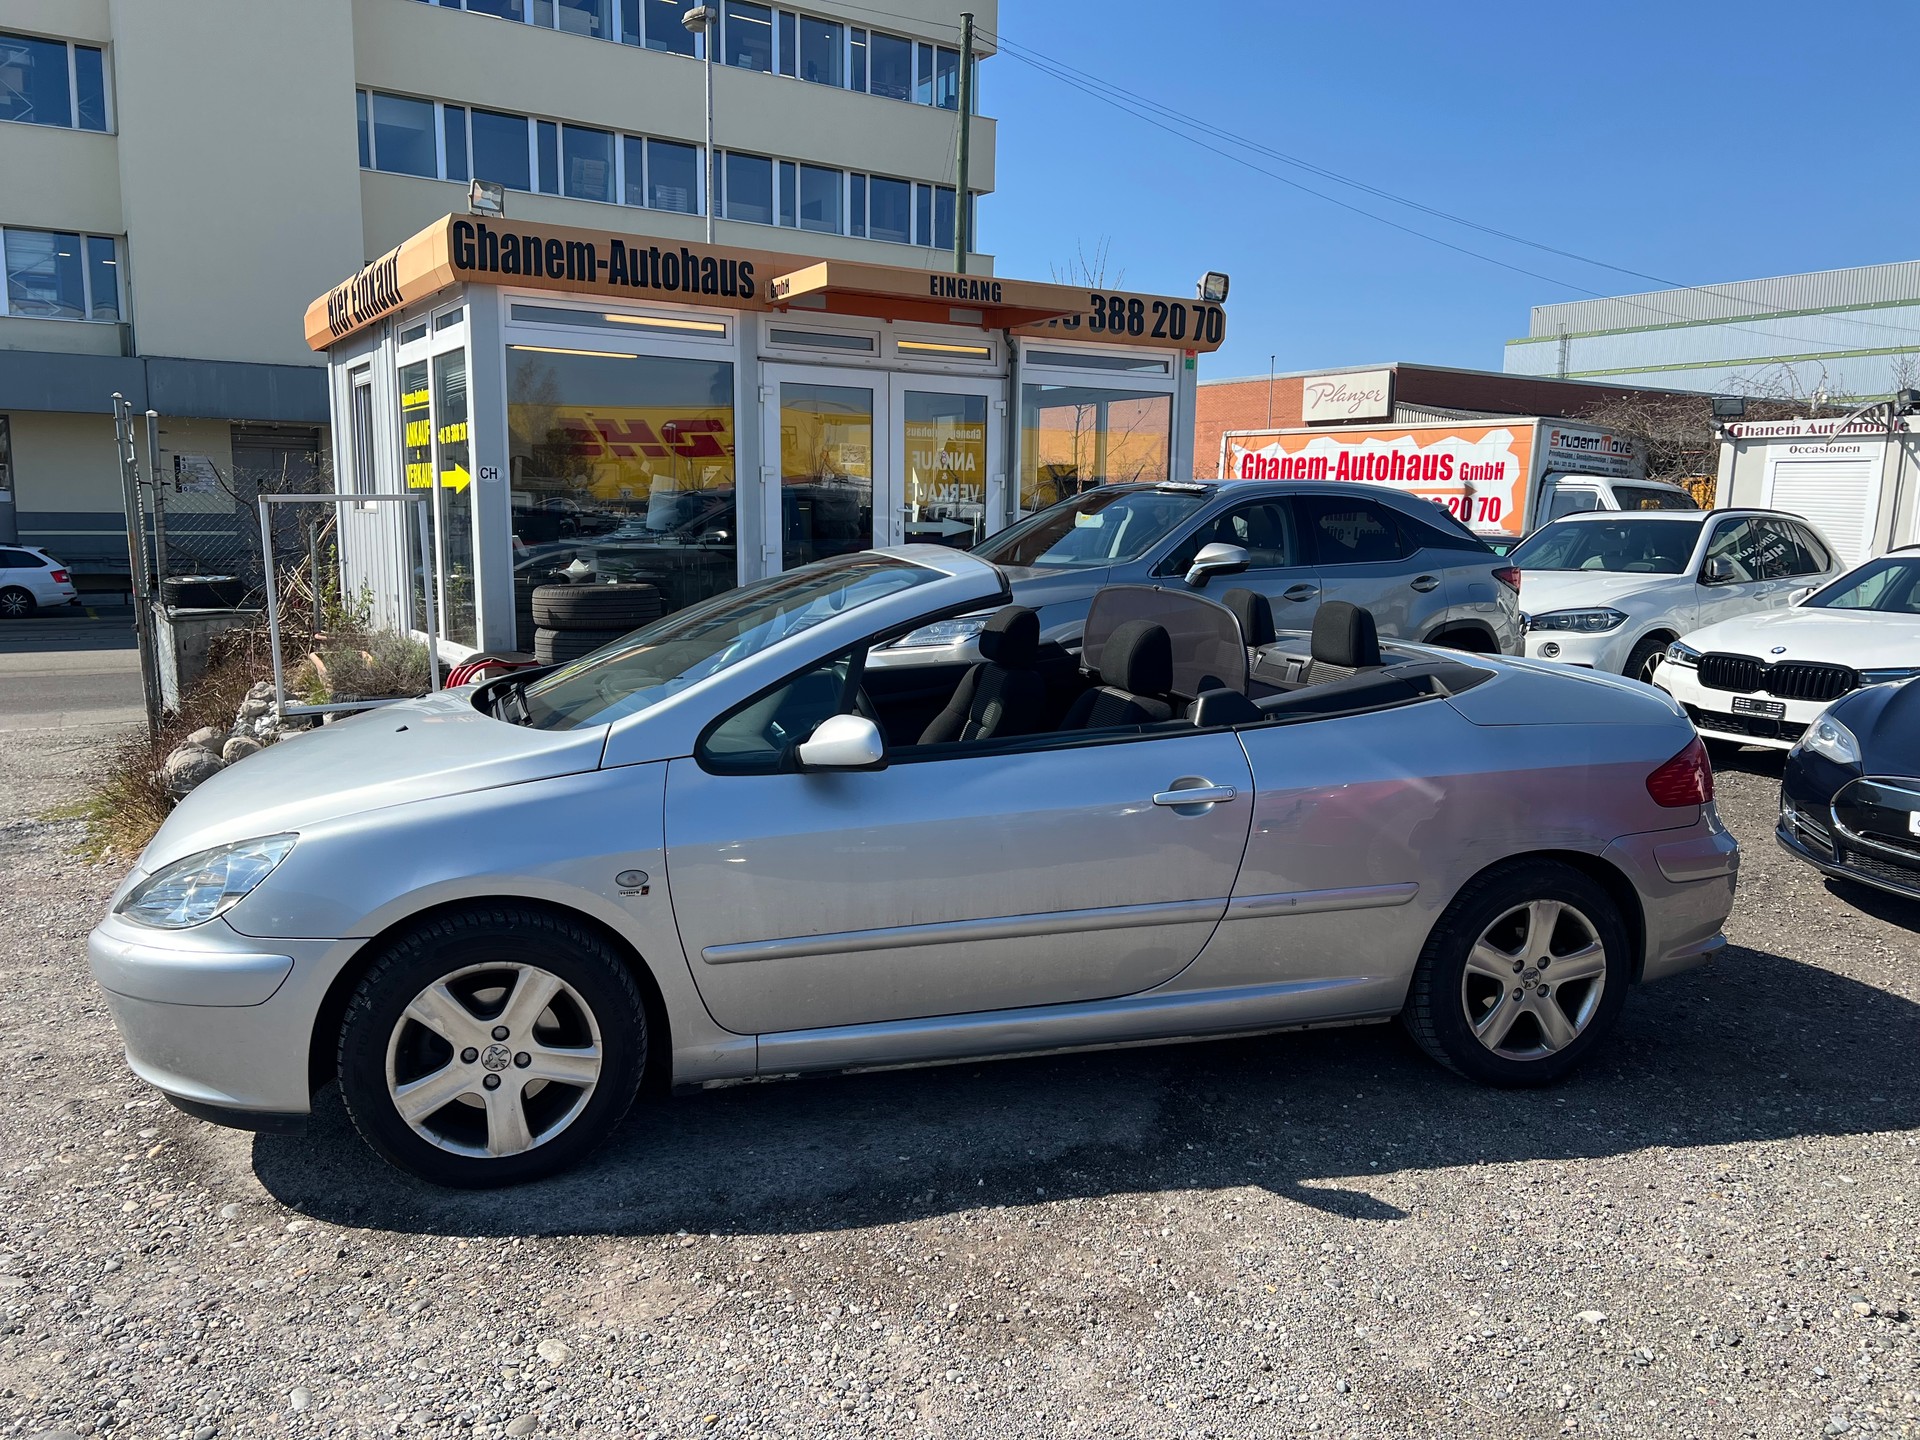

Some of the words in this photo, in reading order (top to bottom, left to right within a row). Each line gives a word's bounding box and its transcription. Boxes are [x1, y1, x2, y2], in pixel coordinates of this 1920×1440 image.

[453, 220, 755, 298] Ghanem-Autohaus
[327, 286, 353, 337] Hier
[351, 246, 404, 323] Einkauf
[930, 275, 1001, 303] EINGANG
[1089, 294, 1145, 336] 388
[1151, 300, 1186, 340] 20
[1192, 304, 1223, 343] 70
[1306, 382, 1385, 413] Planzer
[1728, 421, 1801, 438] Ghanem
[1789, 444, 1861, 454] Occasionen
[480, 467, 498, 480] CH
[1241, 449, 1455, 481] Ghanem-Autohaus
[1460, 461, 1506, 481] GmbH
[1478, 496, 1502, 522] 70
